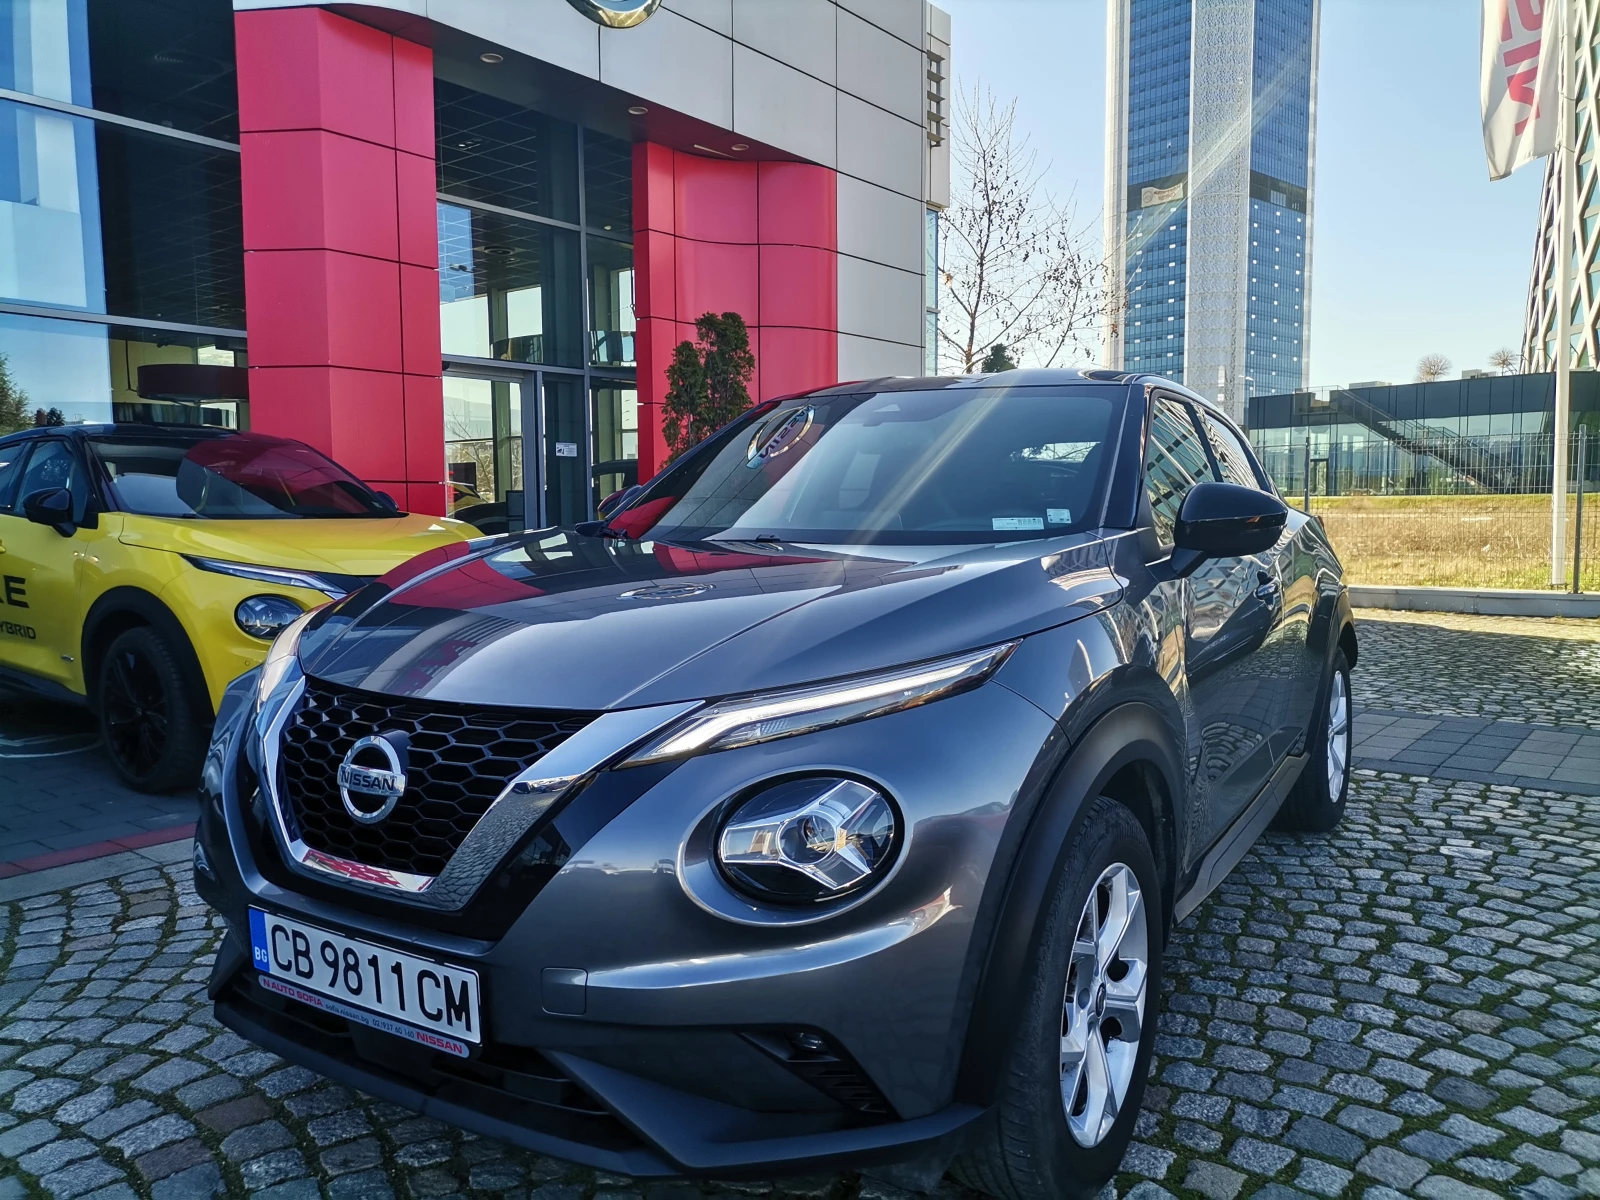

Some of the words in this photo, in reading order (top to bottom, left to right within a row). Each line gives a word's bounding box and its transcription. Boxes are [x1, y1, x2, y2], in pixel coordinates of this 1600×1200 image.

[340, 769, 395, 791] NISSAN
[254, 946, 268, 963] BG
[297, 990, 324, 1007] SOFIA
[416, 1031, 463, 1054] NISSAN
